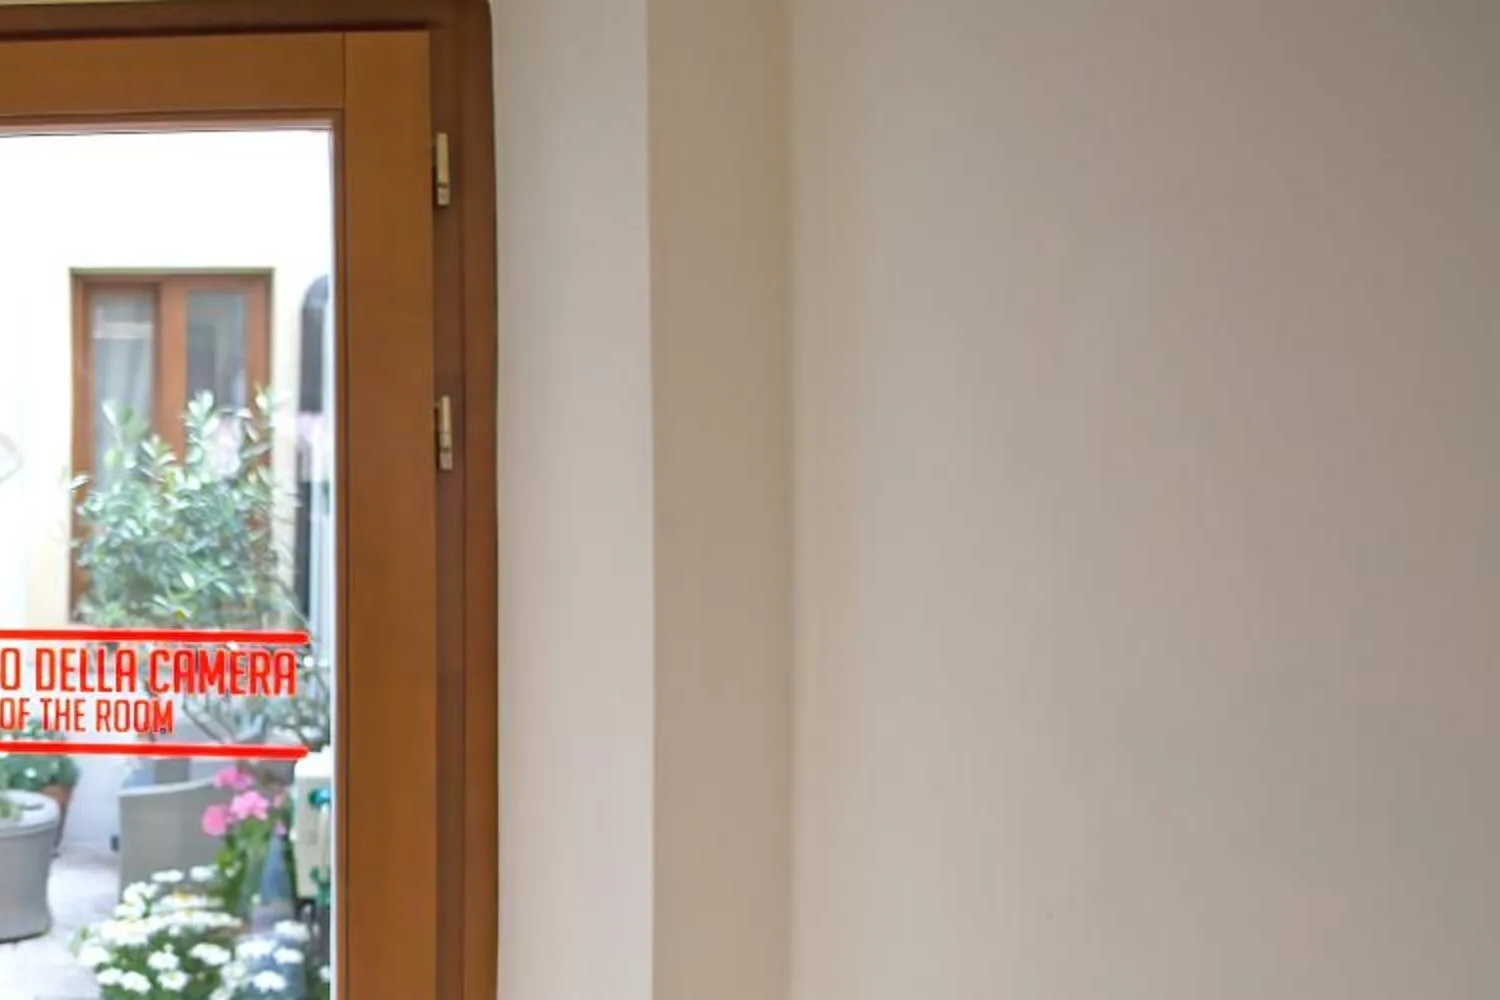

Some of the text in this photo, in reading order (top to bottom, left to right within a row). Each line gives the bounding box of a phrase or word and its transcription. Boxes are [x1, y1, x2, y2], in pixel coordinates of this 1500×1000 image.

[35, 647, 137, 693] DELLA
[150, 649, 297, 696] CAMERA
[0, 697, 30, 731] OF
[39, 698, 86, 732] THE
[95, 699, 174, 733] ROOM
